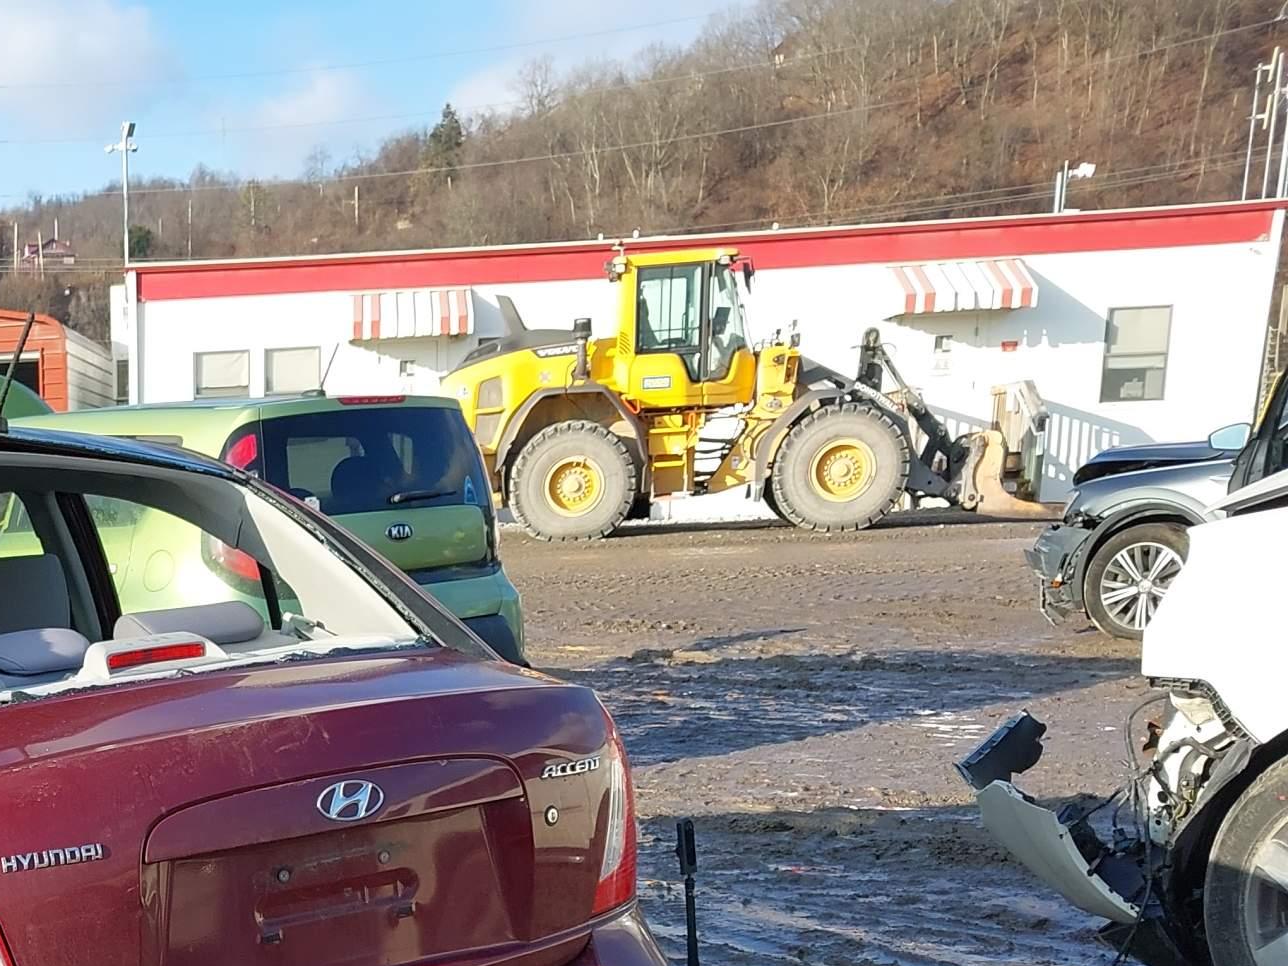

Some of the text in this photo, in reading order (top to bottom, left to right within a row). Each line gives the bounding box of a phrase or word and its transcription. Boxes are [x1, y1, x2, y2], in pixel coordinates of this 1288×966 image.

[391, 525, 411, 539] KIA
[541, 756, 601, 779] ACCENT
[0, 843, 104, 873] HYUNDAI
